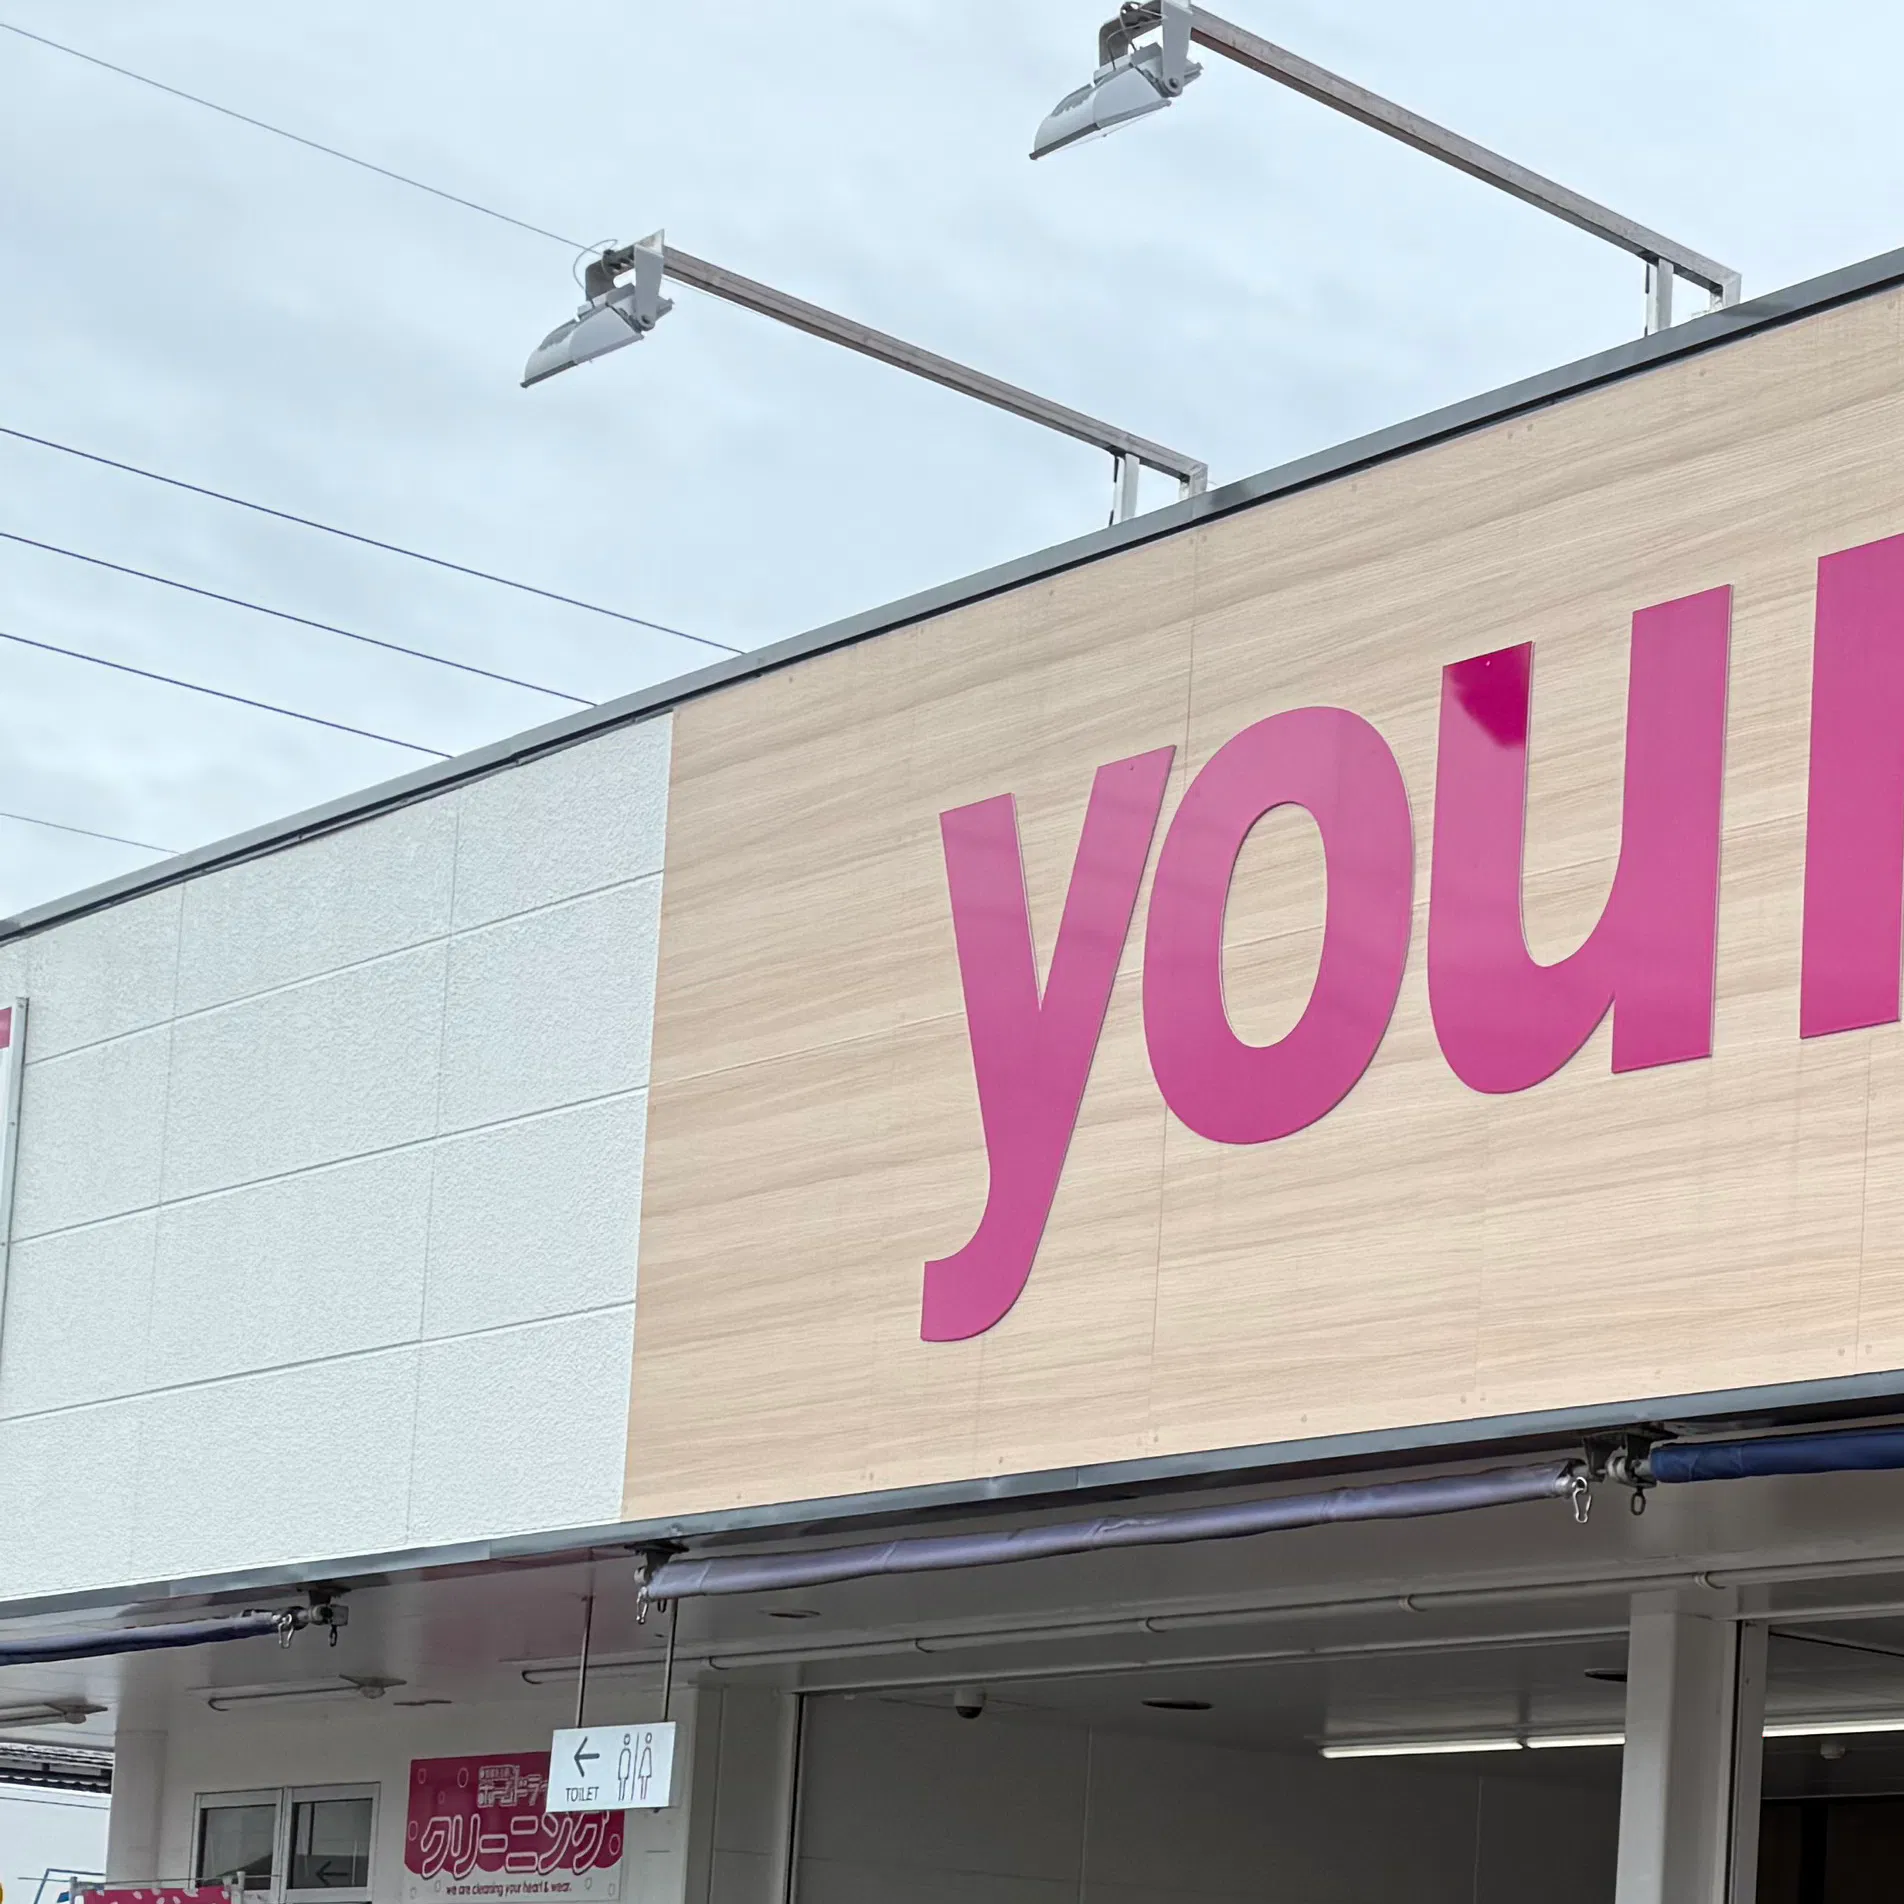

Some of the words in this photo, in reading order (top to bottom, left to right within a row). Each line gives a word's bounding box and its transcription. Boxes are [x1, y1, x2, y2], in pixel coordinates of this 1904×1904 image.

[565, 1786, 599, 1802] TOILET
[420, 1810, 610, 1879] クリーニング
[458, 1884, 471, 1895] are
[472, 1882, 505, 1897] cleaning
[505, 1883, 521, 1898] your
[522, 1881, 542, 1894] heart
